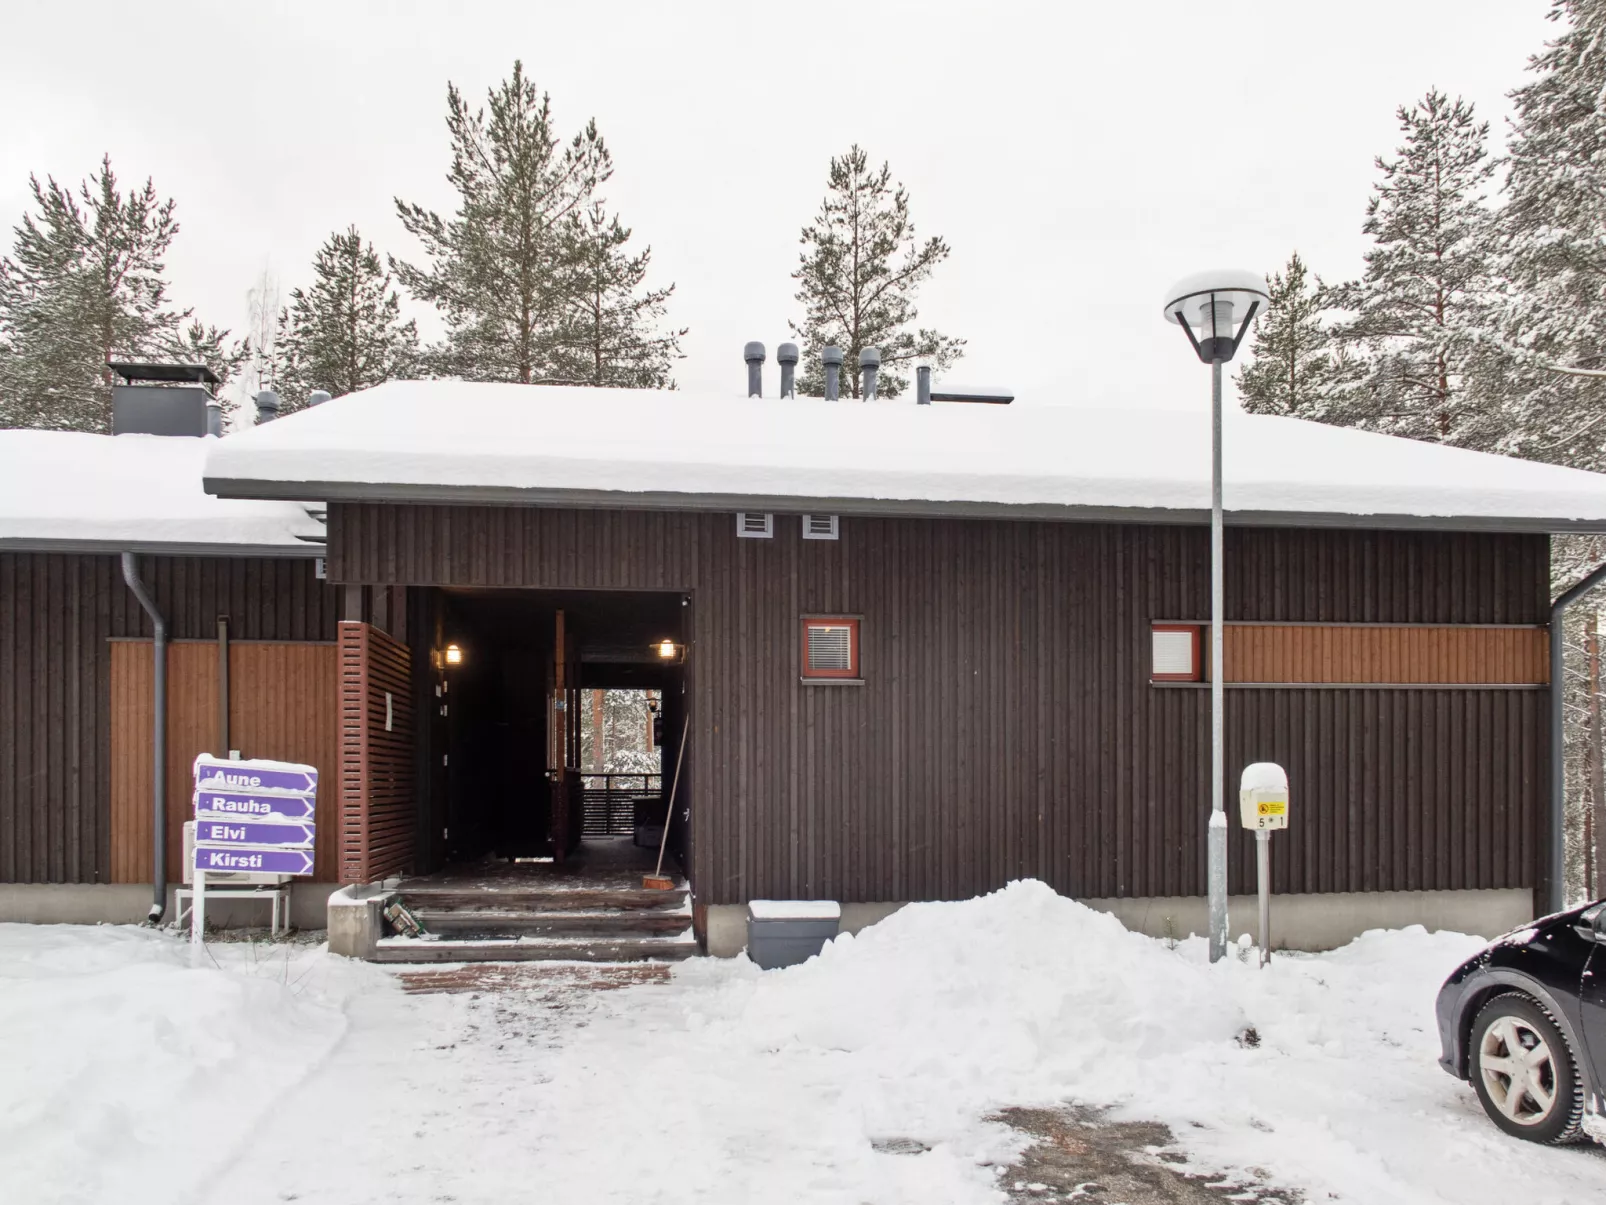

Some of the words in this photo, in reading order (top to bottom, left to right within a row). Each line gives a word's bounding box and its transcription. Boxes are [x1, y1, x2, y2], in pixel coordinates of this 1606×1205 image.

[214, 770, 261, 787] Aune
[212, 797, 271, 813] Rauha
[210, 825, 246, 840] Elvi
[209, 852, 263, 868] Kirsti
